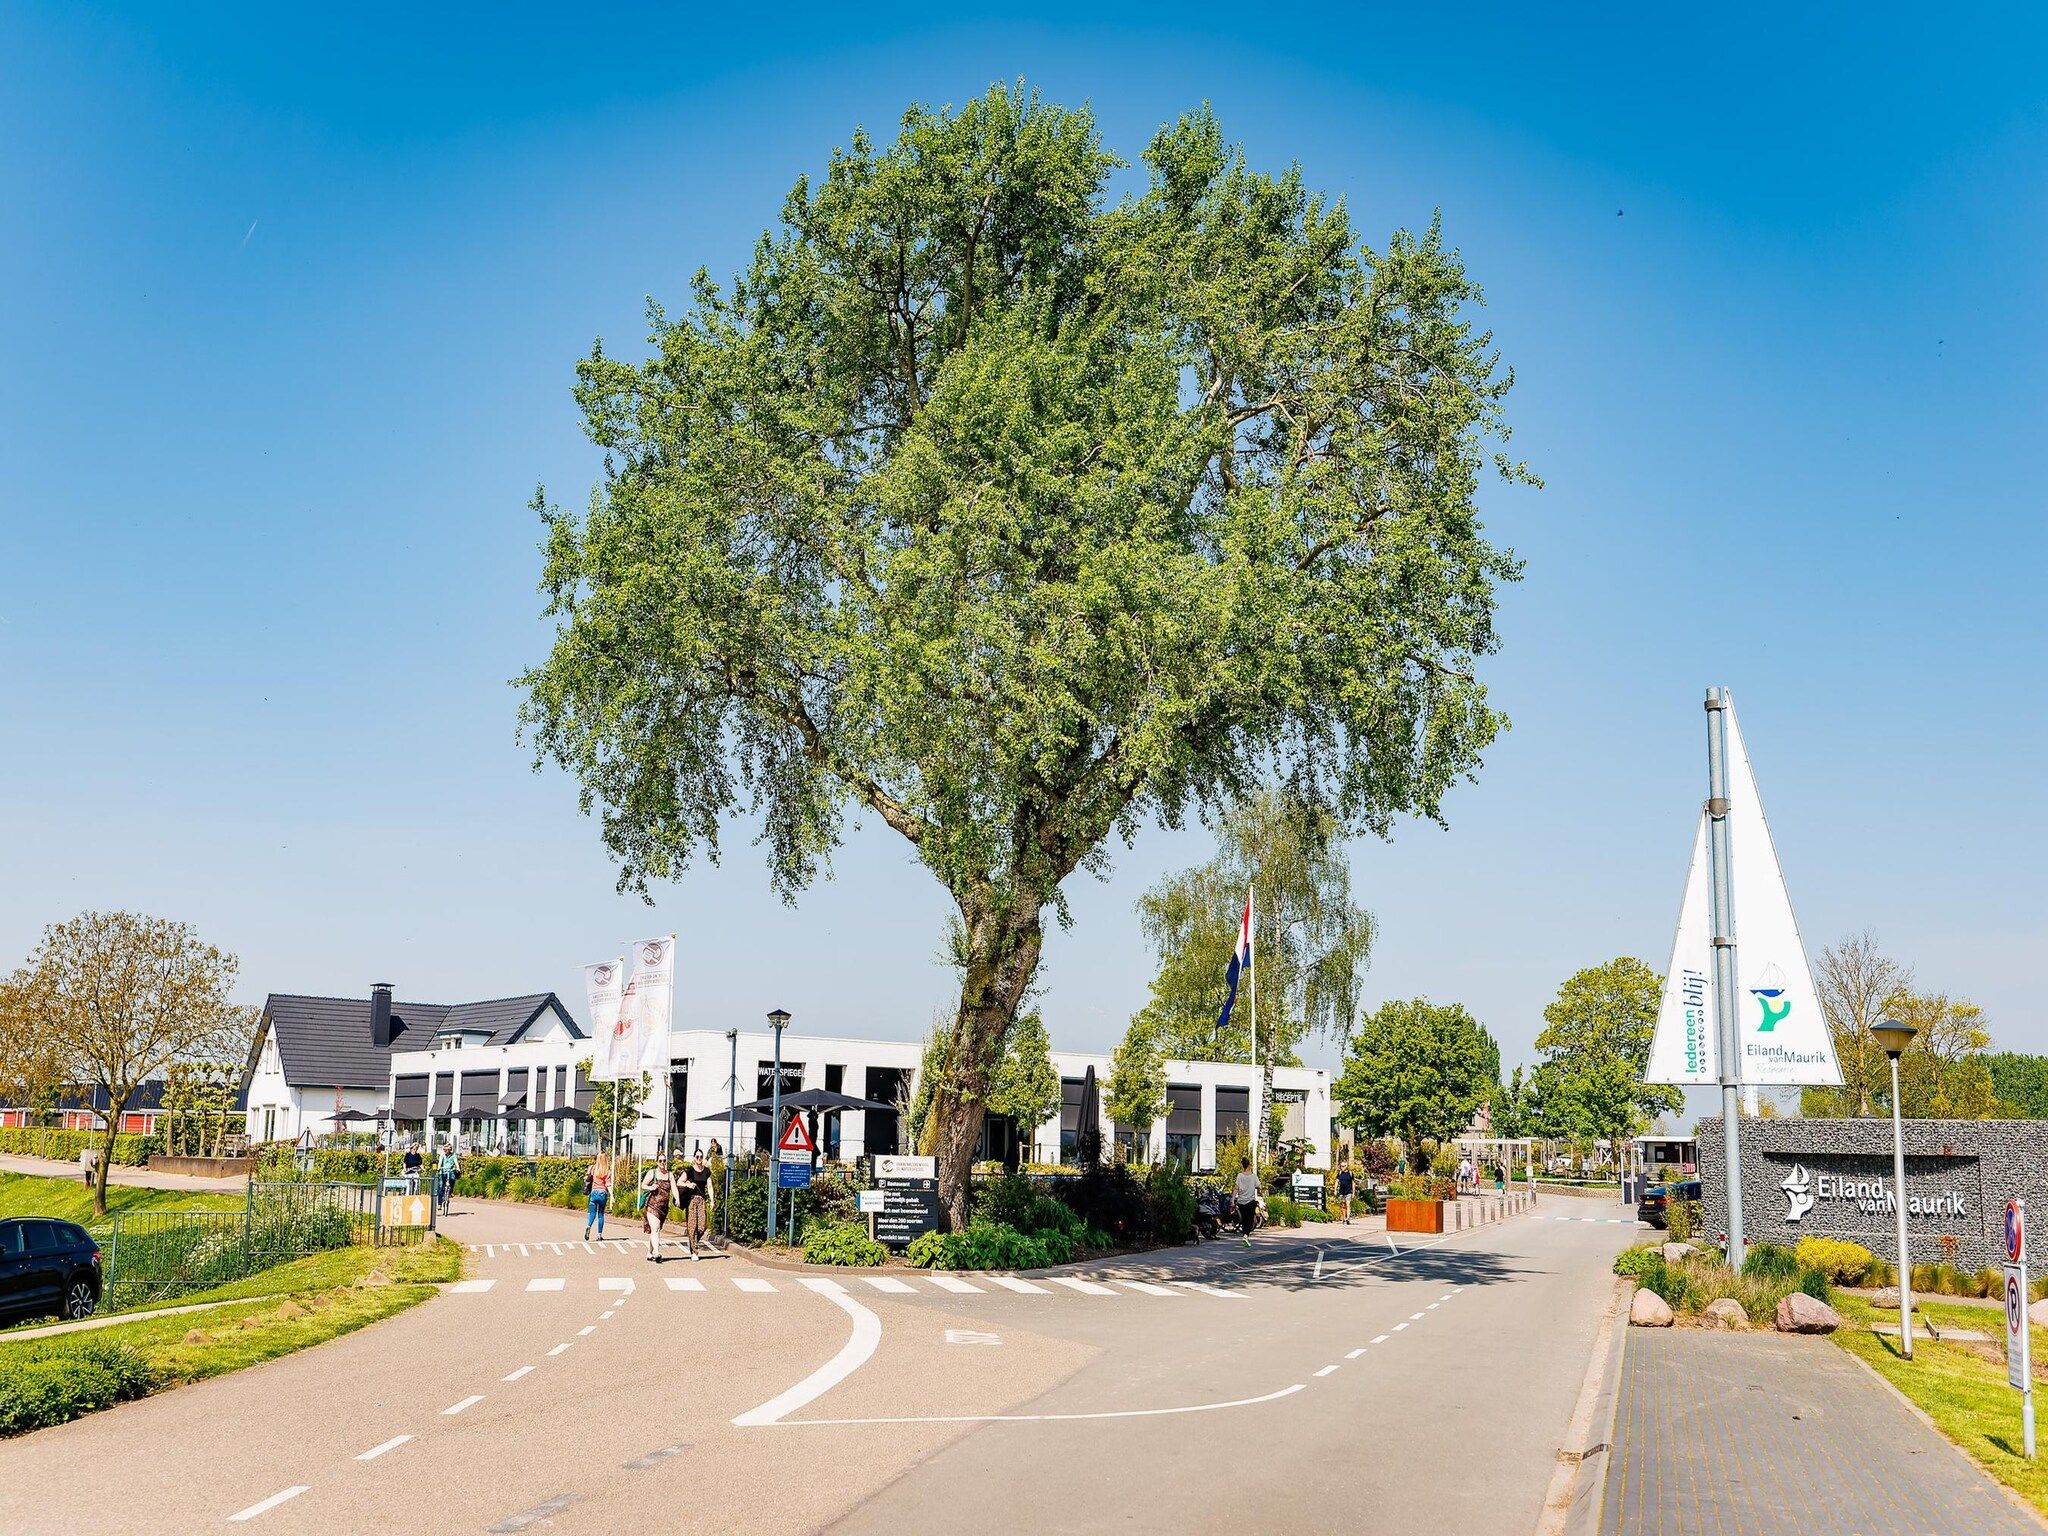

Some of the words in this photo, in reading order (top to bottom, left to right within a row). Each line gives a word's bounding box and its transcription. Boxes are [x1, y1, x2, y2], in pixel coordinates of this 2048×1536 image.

[1683, 969, 1708, 1007] blij!
[1747, 1044, 1783, 1056] Eiland
[1784, 1051, 1827, 1063] Maurik
[758, 1067, 805, 1077] WATESPIEGEL
[1276, 1092, 1303, 1102] RECEPTIE
[1818, 1176, 1884, 1200] Eiland
[1858, 1198, 1886, 1212] van
